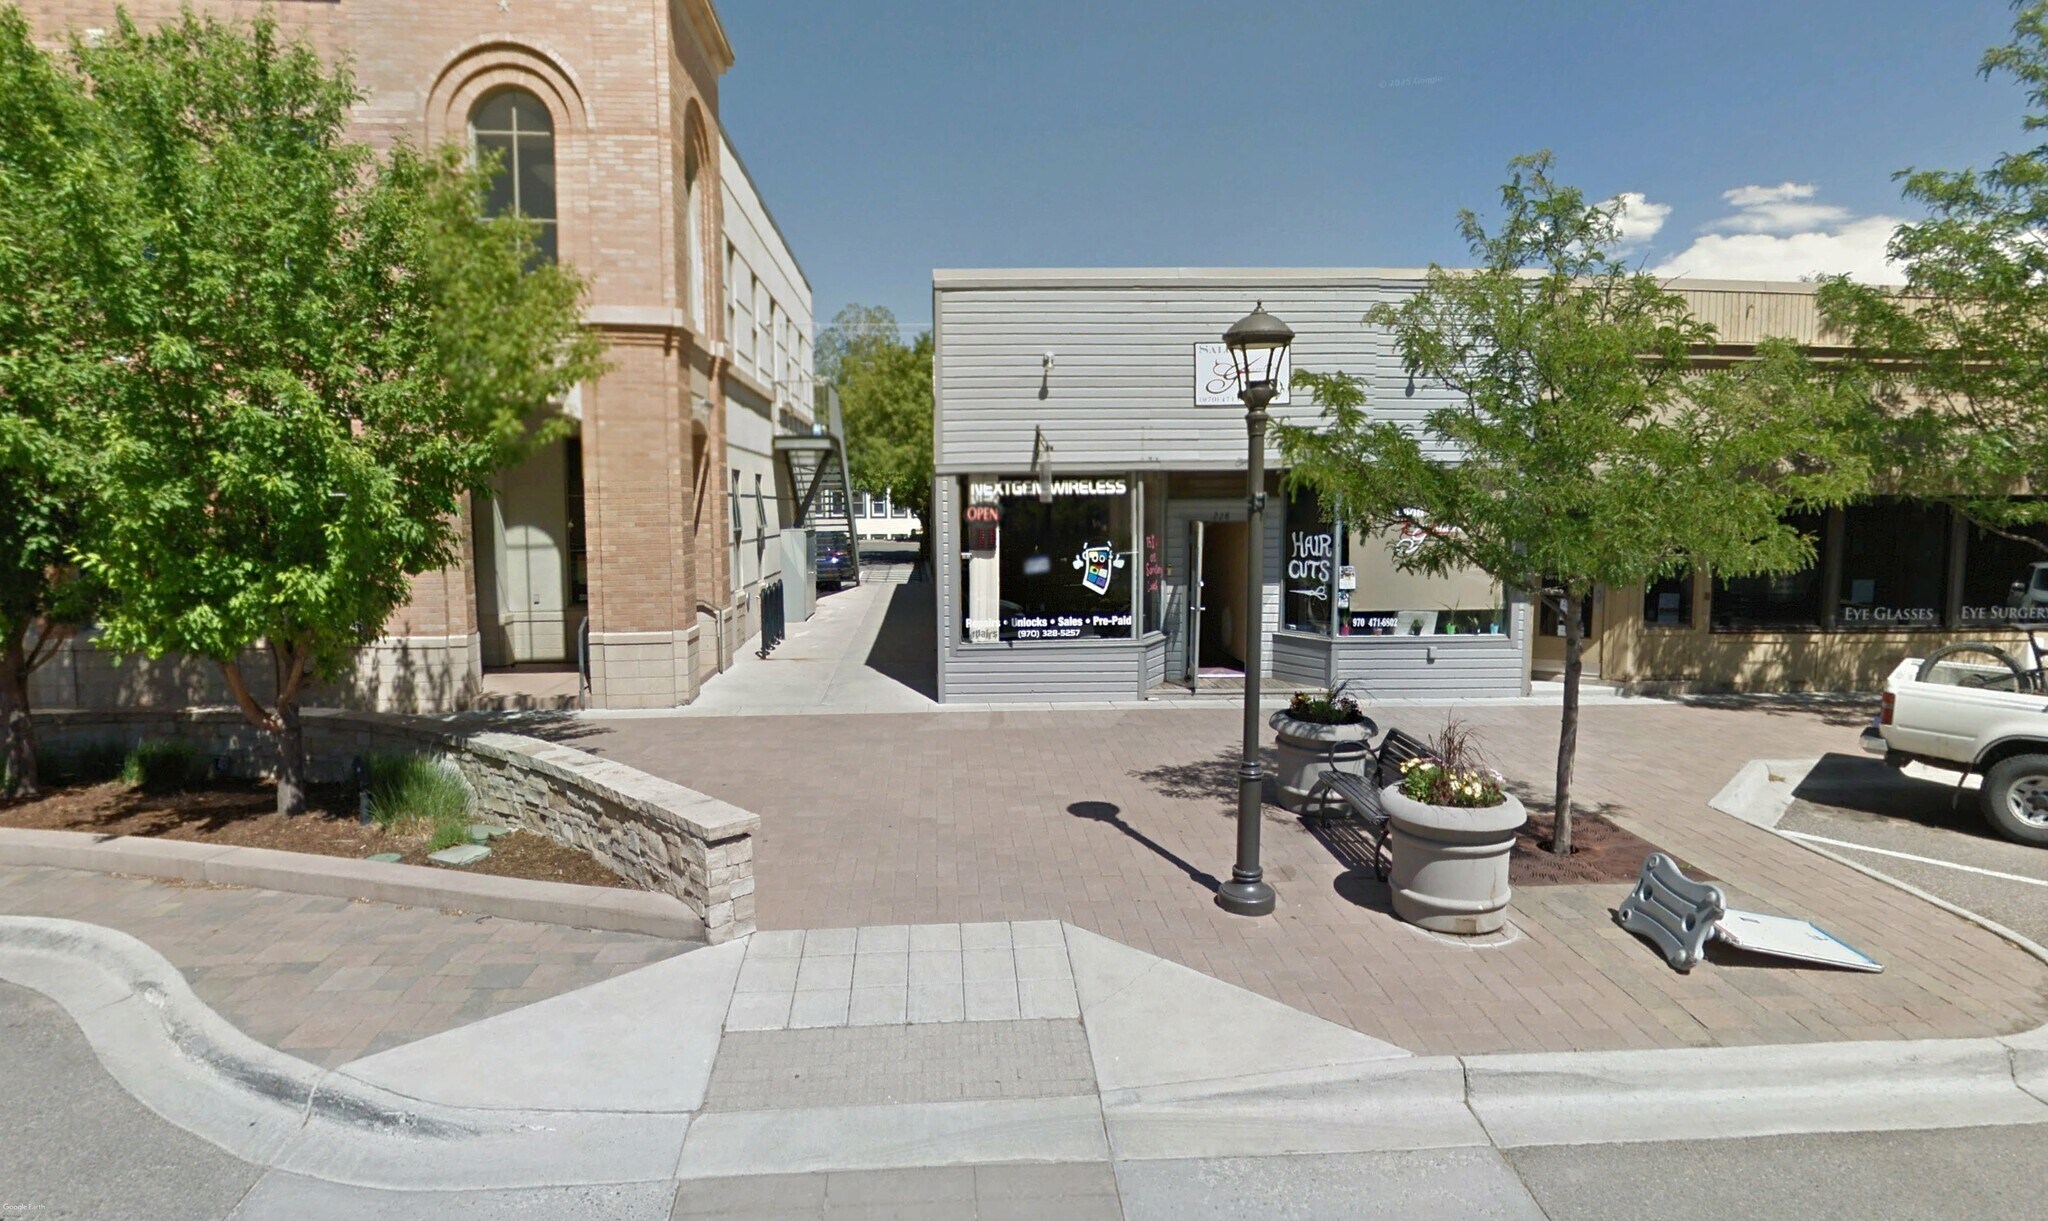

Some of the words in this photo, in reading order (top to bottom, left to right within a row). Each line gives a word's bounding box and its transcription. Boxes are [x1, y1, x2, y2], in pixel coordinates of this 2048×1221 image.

[1050, 480, 1127, 496] WIRELESS
[966, 506, 998, 522] OPEN
[1291, 531, 1332, 557] HAIR
[1288, 560, 1330, 582] CUTS
[1845, 607, 1870, 621] EYE
[1874, 606, 1934, 621] GLASSES
[1961, 605, 1986, 619] EYE
[1011, 616, 1048, 628] Unlocks
[1057, 615, 1083, 627] Sales
[1093, 615, 1132, 626] Pre-Paid
[1352, 617, 1365, 627] 970
[1017, 629, 1040, 638] (970)
